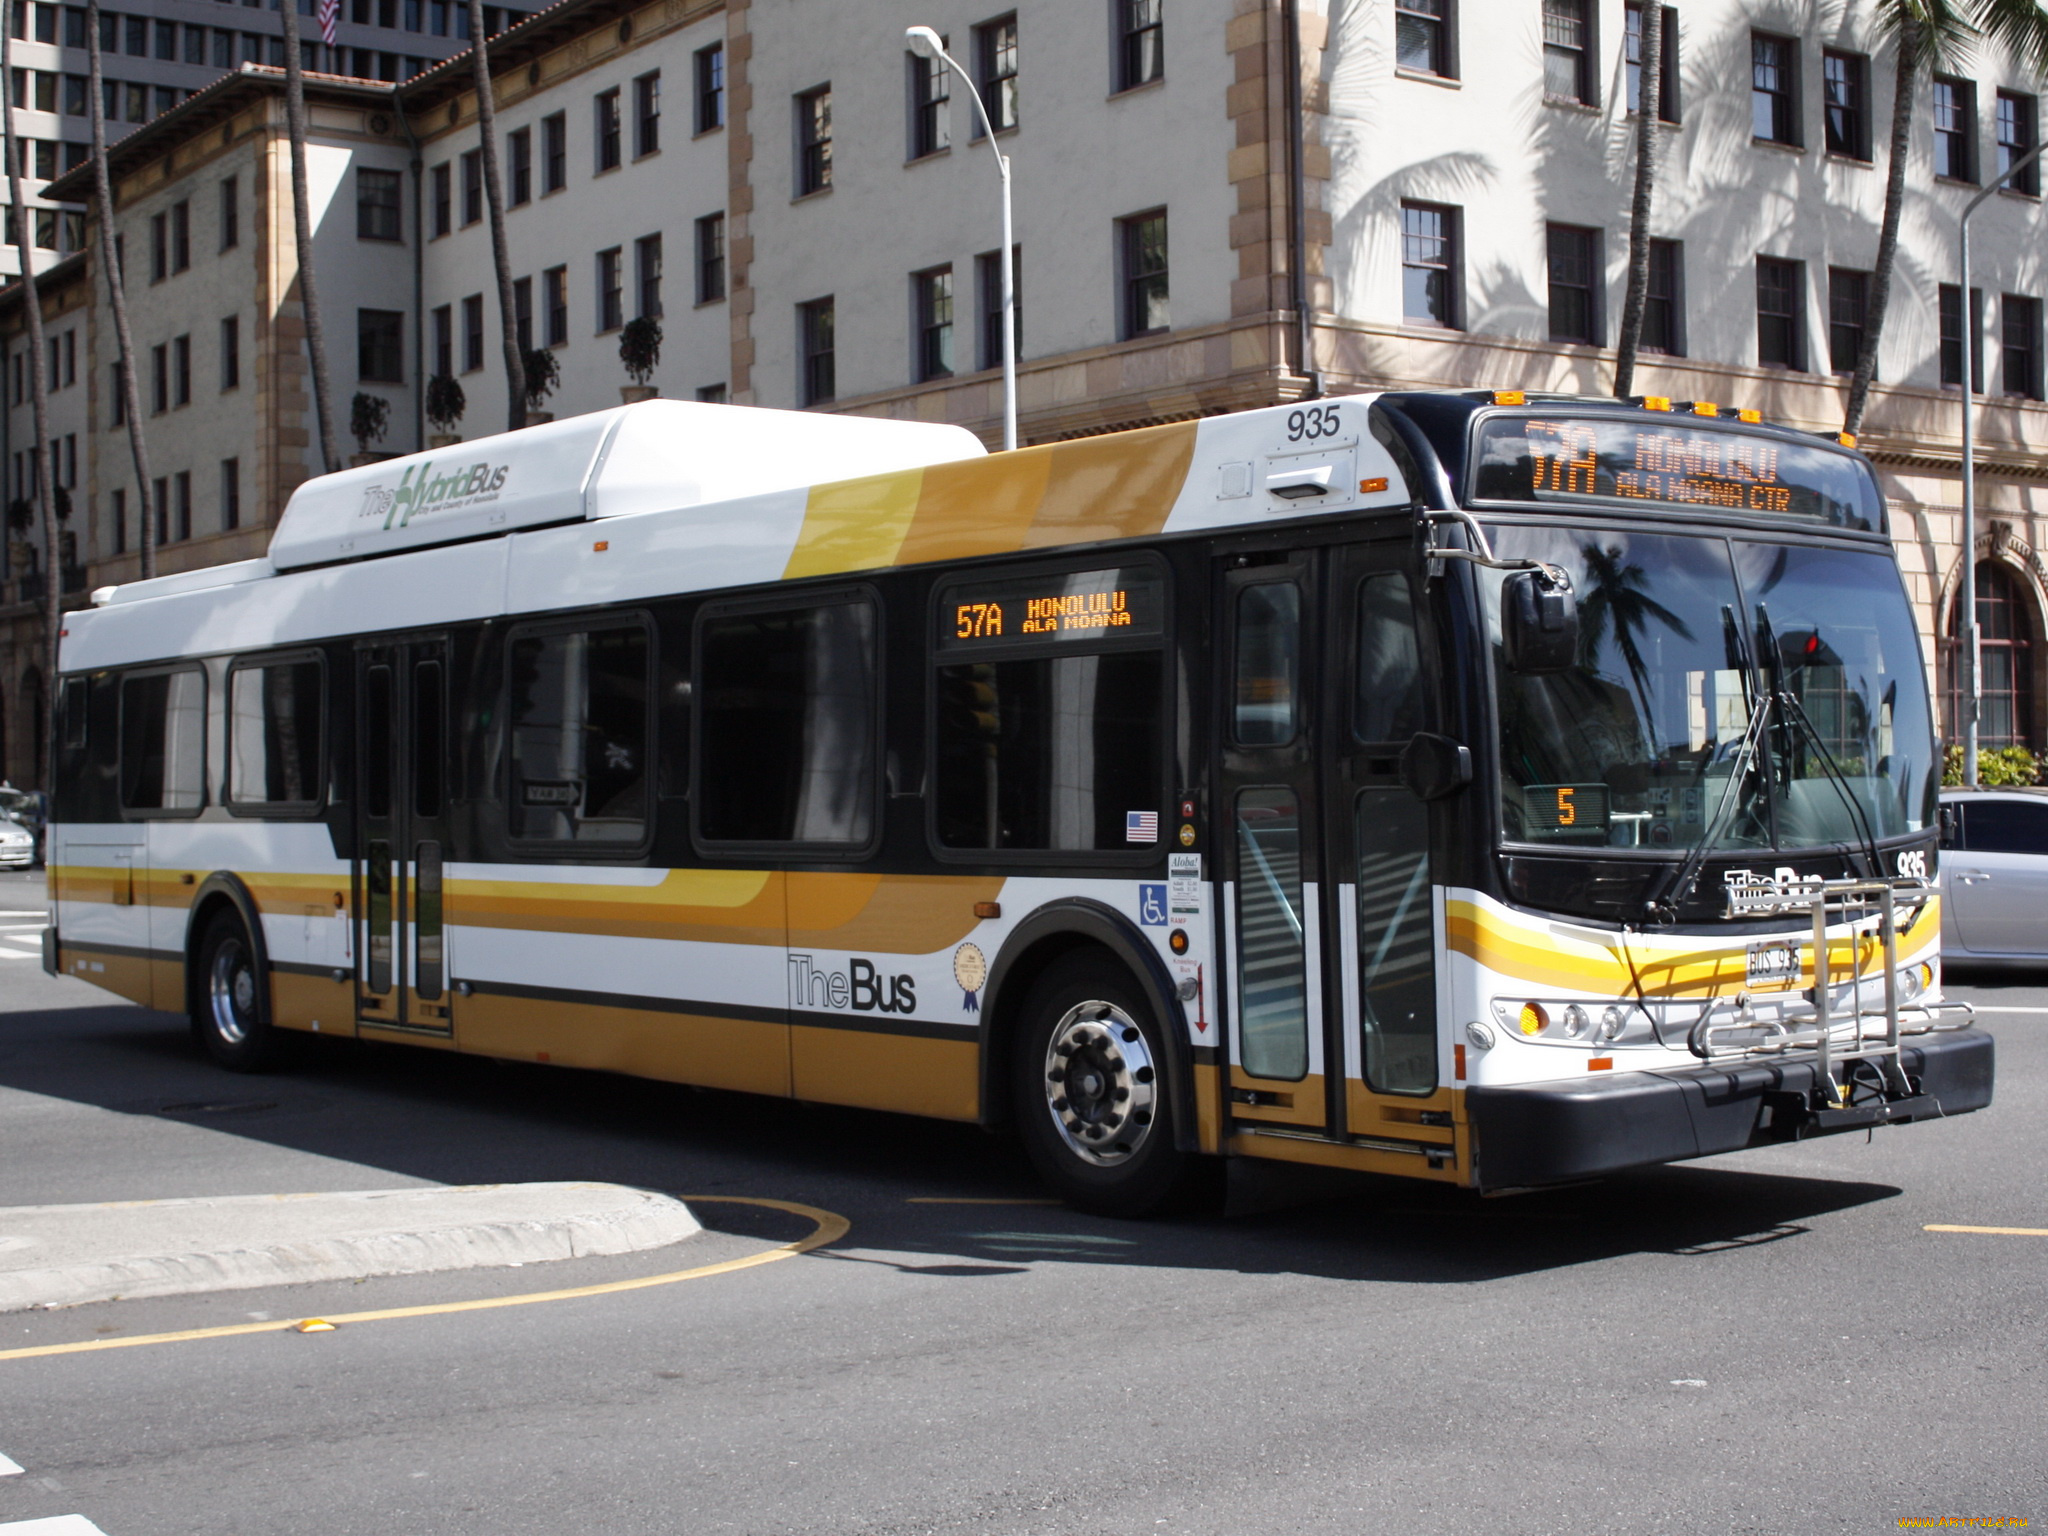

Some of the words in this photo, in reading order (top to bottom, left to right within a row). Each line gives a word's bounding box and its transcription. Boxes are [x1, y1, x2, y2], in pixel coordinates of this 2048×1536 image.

[1288, 404, 1341, 442] 935
[1636, 433, 1778, 483] HONOLULU
[431, 503, 442, 512] and
[443, 499, 463, 510] County
[1616, 472, 1661, 499] ALA
[1668, 477, 1743, 508] MOANA
[1750, 485, 1791, 511] CTR
[1028, 591, 1126, 619] HONOLULU
[957, 603, 1002, 638] 57A
[1023, 618, 1058, 633] ALA
[1063, 612, 1131, 630] MOANA
[1557, 788, 1575, 824] 5
[1171, 856, 1198, 867] Aloha!
[1897, 851, 1926, 878] 935
[1180, 965, 1191, 973] Bus
[1750, 950, 1771, 975] BUS
[1779, 947, 1799, 971] 935
[789, 954, 917, 1014] TheBus
